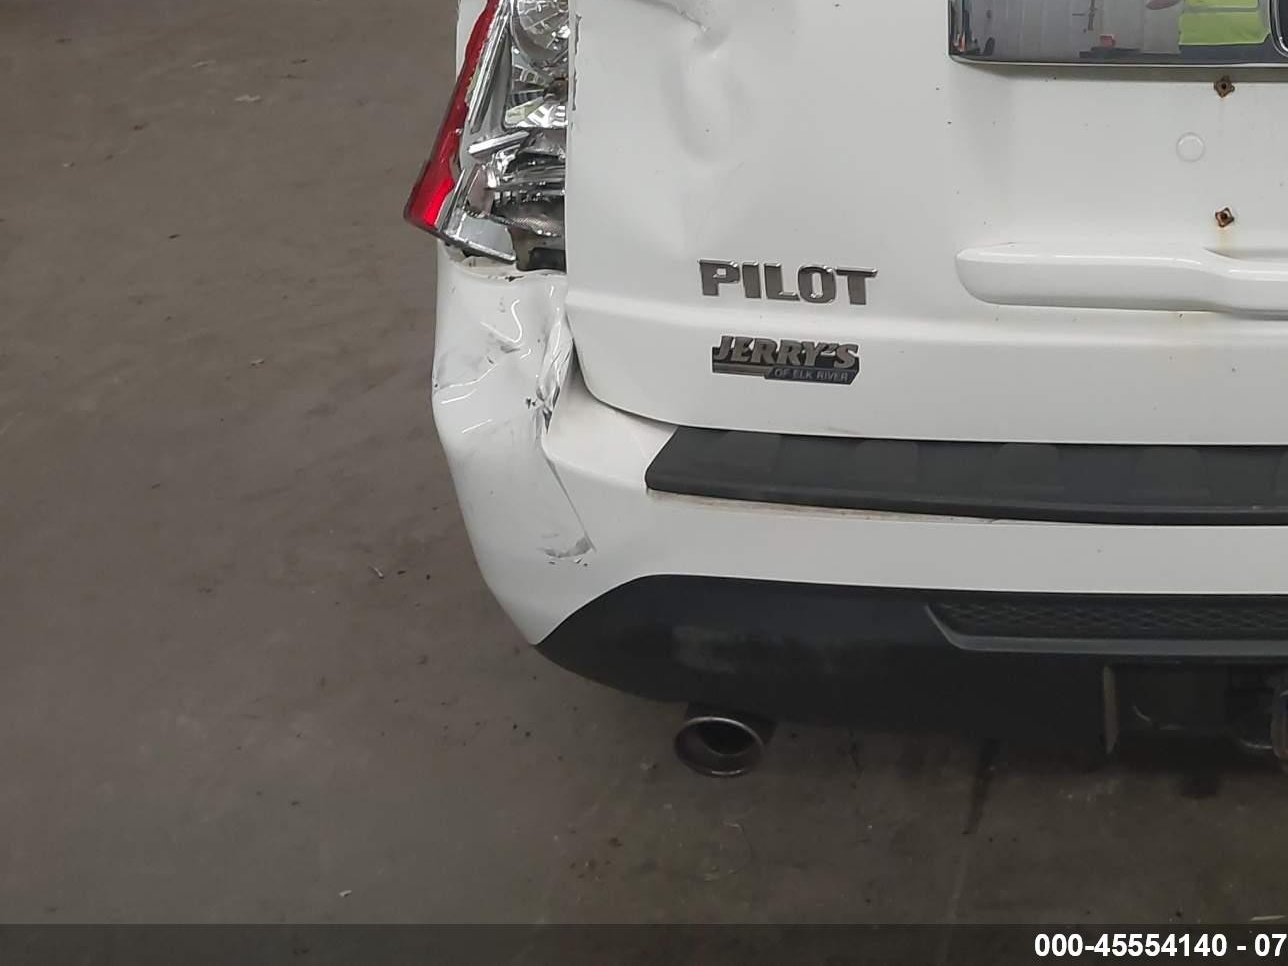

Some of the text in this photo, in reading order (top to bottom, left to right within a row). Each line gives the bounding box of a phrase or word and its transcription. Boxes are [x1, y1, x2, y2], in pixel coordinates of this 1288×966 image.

[699, 259, 878, 305] PILOT
[714, 335, 859, 369] JERRY'S
[774, 368, 848, 382] OF ELK RIVER
